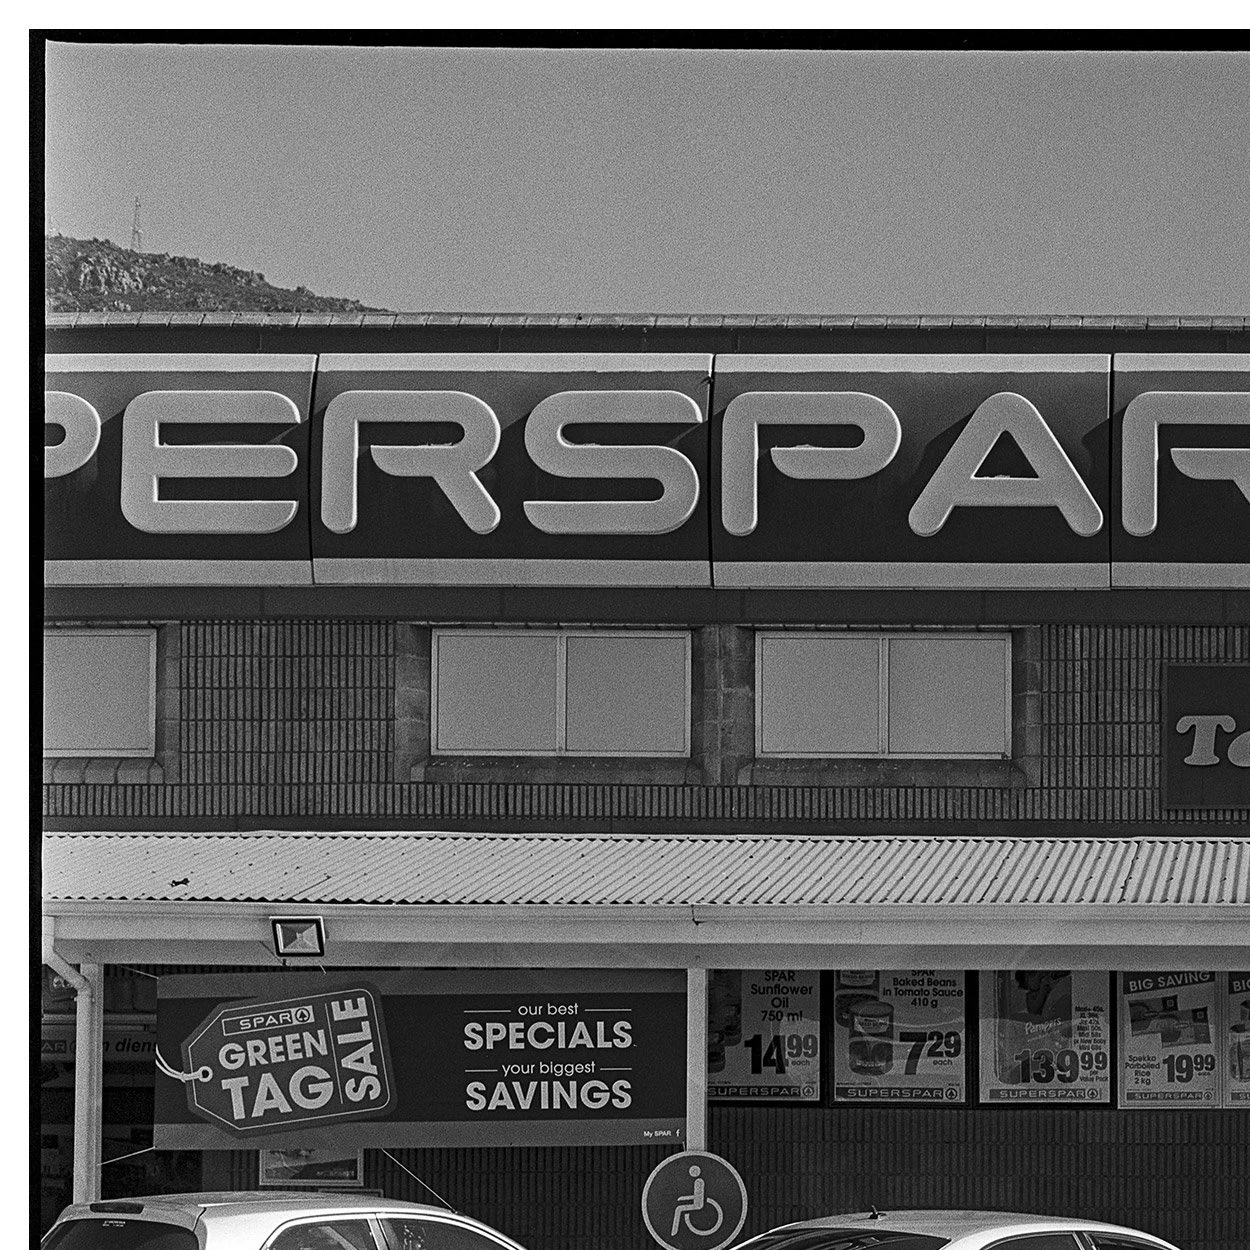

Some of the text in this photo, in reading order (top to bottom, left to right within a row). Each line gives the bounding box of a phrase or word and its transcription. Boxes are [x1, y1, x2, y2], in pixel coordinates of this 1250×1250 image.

[764, 970, 796, 982] SPAR
[892, 977, 957, 987] Baked Beans
[1129, 971, 1211, 992] BIG SAVING
[751, 983, 814, 995] Sunflower
[894, 987, 931, 997] Tomato
[932, 988, 964, 997] Sauce
[518, 1002, 579, 1016] our best
[771, 997, 789, 1009] Oil
[910, 998, 938, 1009] 410 g
[239, 1011, 292, 1031] SPAR
[761, 1010, 803, 1022] 750 ml
[463, 1021, 633, 1051] SPECIALS
[218, 1029, 328, 1071] GREEN
[330, 997, 381, 1102] SALE
[501, 1061, 596, 1077] your biggest
[1134, 1077, 1151, 1086] 2 kg
[221, 1065, 334, 1120] TAG
[465, 1079, 632, 1111] SAVINGS
[708, 1087, 800, 1096] SUPERSPAR
[847, 1088, 942, 1098] SUPERSPAR
[999, 1089, 1085, 1098] SUPERSPAR
[1134, 1092, 1202, 1100] SUPERSPAR
[643, 1130, 654, 1139] My
